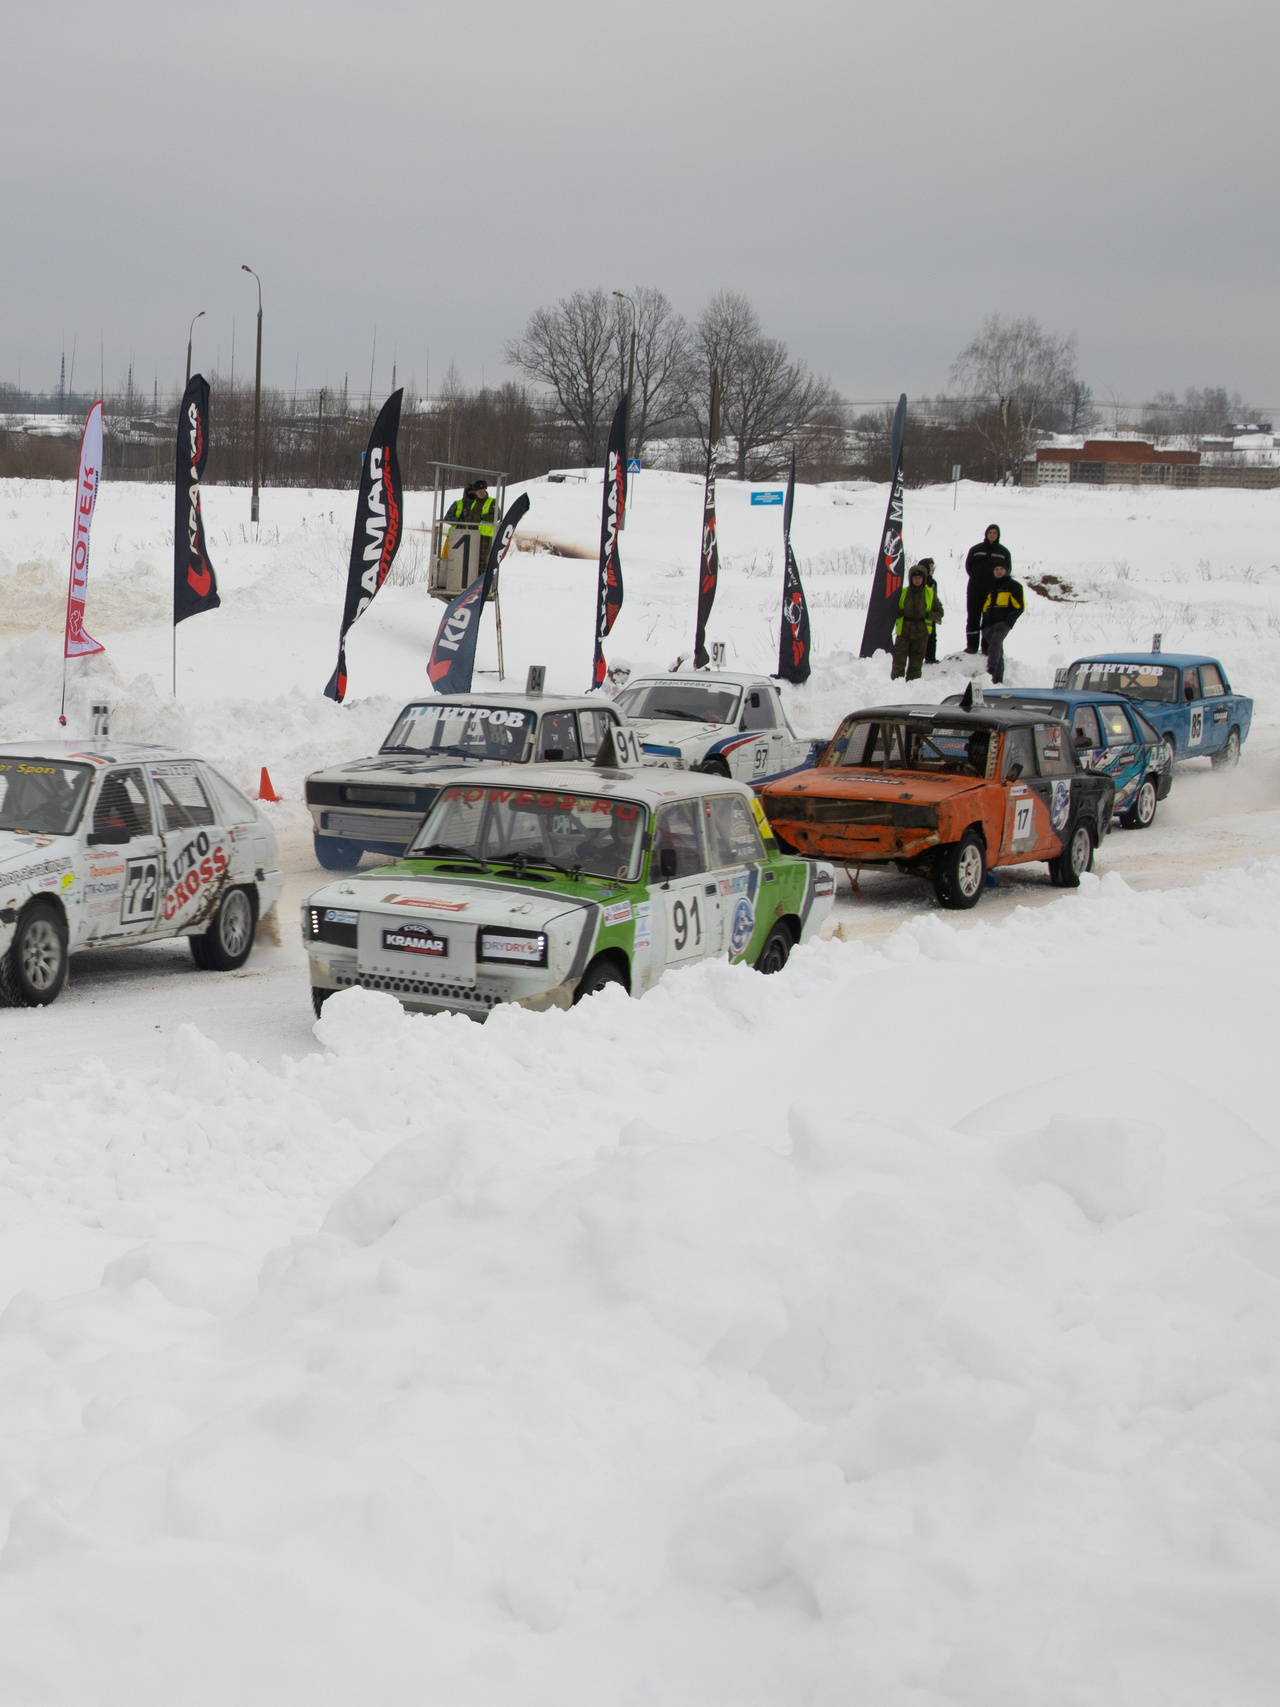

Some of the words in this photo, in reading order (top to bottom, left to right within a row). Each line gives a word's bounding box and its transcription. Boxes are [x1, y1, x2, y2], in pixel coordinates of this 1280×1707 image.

[350, 447, 384, 623] RAMAR
[451, 534, 471, 589] 1
[712, 643, 725, 663] 97
[654, 680, 713, 688] Ивантеевка
[91, 705, 109, 736] 72
[402, 705, 526, 728] ДМИТРОВ
[1191, 713, 1202, 739] 85
[616, 730, 640, 764] 91
[755, 748, 769, 769] 97
[443, 787, 639, 821] ROWE62.RU
[1017, 808, 1030, 831] 17
[127, 863, 157, 915] 72
[163, 846, 226, 921] CROSS
[672, 896, 702, 951] 91
[386, 934, 444, 952] KRAMAR
